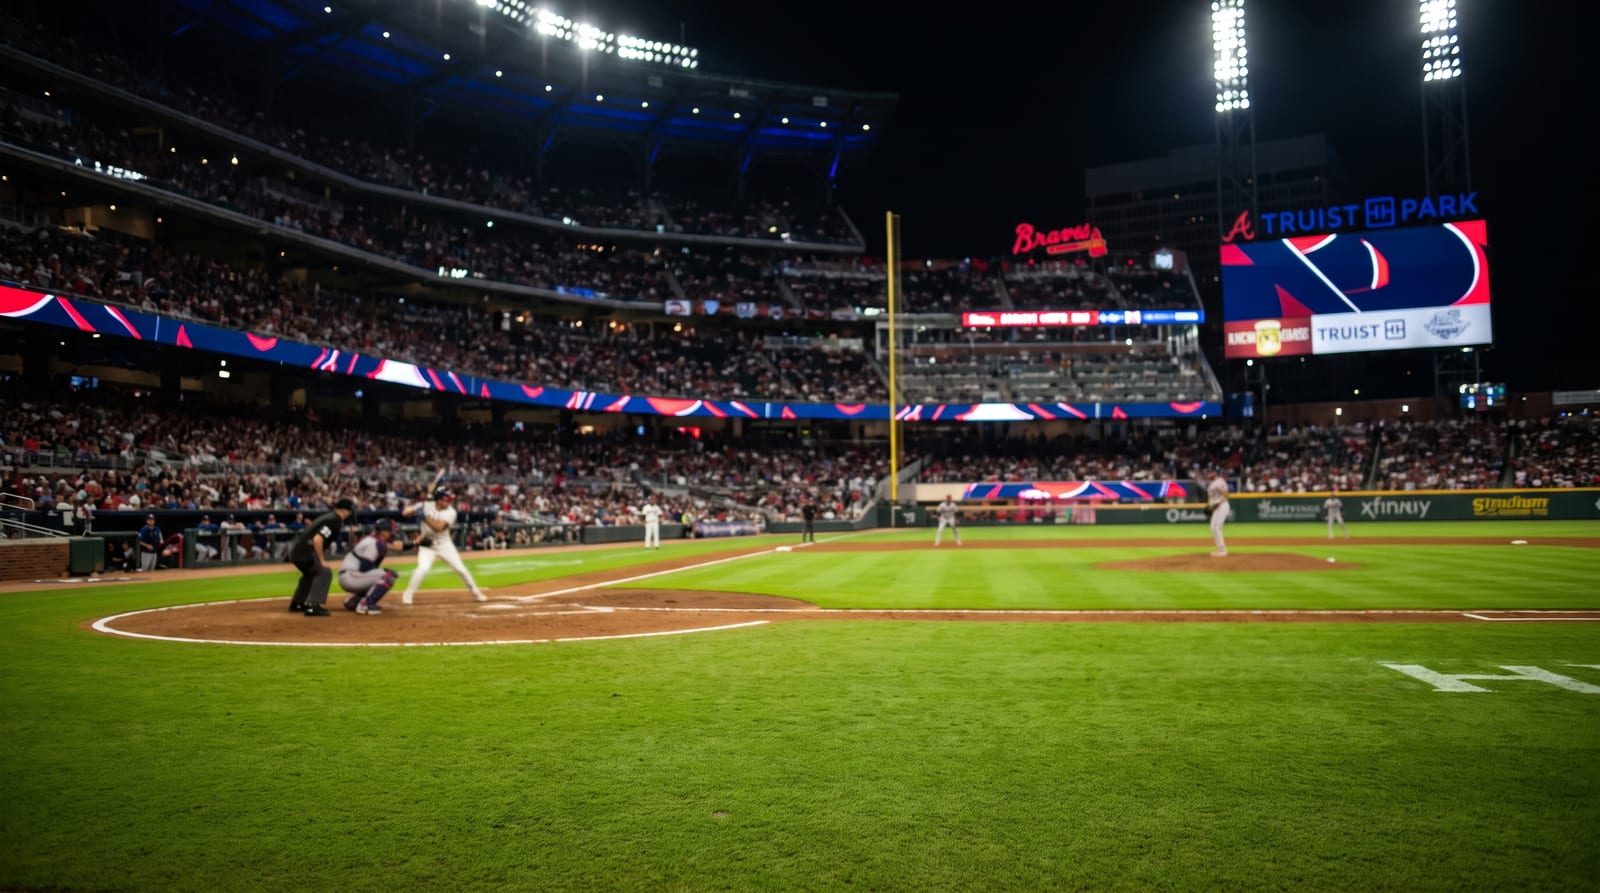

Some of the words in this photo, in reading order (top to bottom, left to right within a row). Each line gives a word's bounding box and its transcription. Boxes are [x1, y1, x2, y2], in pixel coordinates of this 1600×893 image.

[1261, 203, 1359, 234] TRUIST
[1401, 191, 1478, 221] PARK
[1012, 222, 1091, 255] Braves
[1317, 323, 1380, 341] TRUIST
